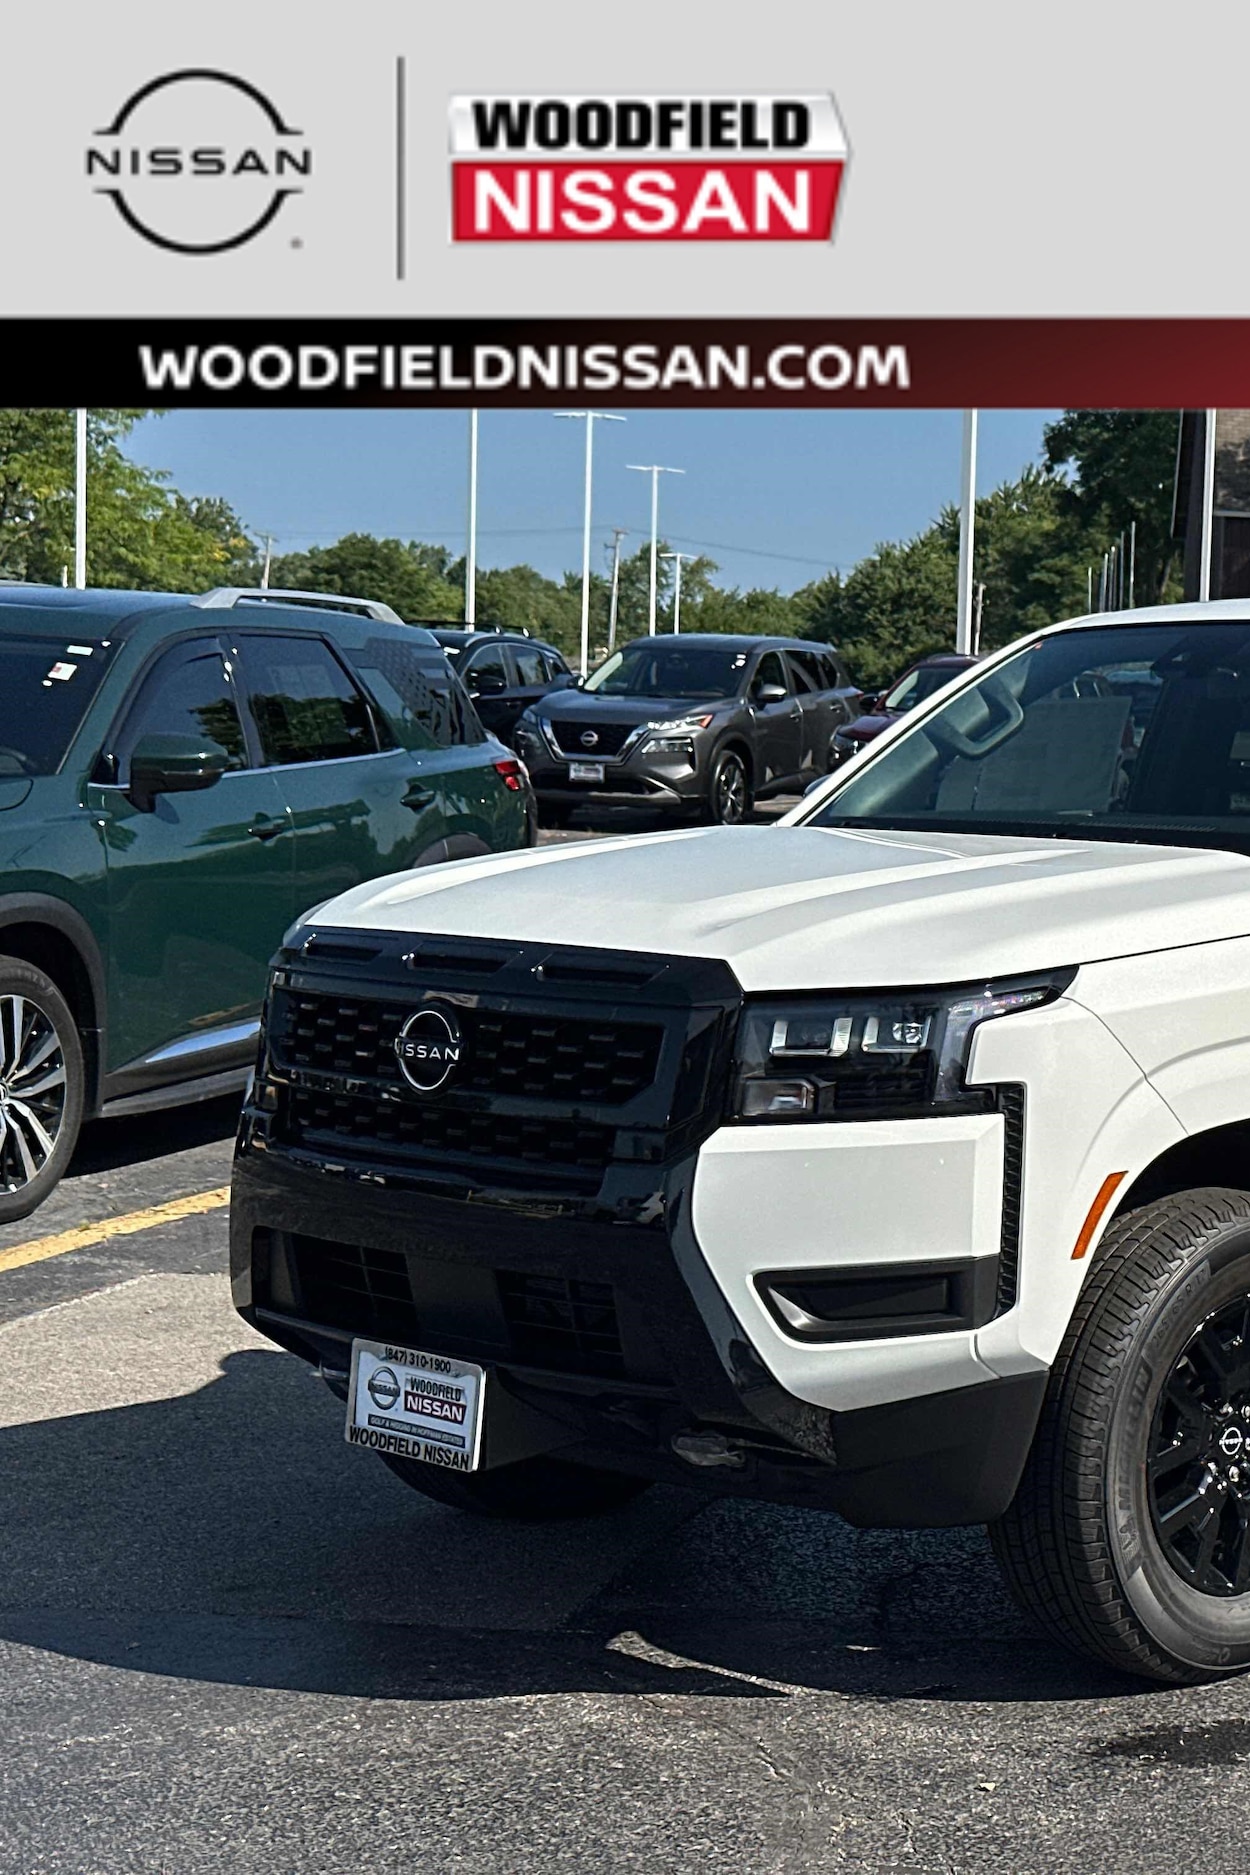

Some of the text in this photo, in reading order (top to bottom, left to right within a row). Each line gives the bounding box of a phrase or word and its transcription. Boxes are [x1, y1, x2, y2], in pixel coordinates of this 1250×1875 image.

[385, 1346, 451, 1374] (847) 310-1900
[410, 1376, 464, 1401] WOODFIELD
[407, 1396, 463, 1422] NISSAN
[350, 1425, 470, 1471] WOODFIELD NISSAN
